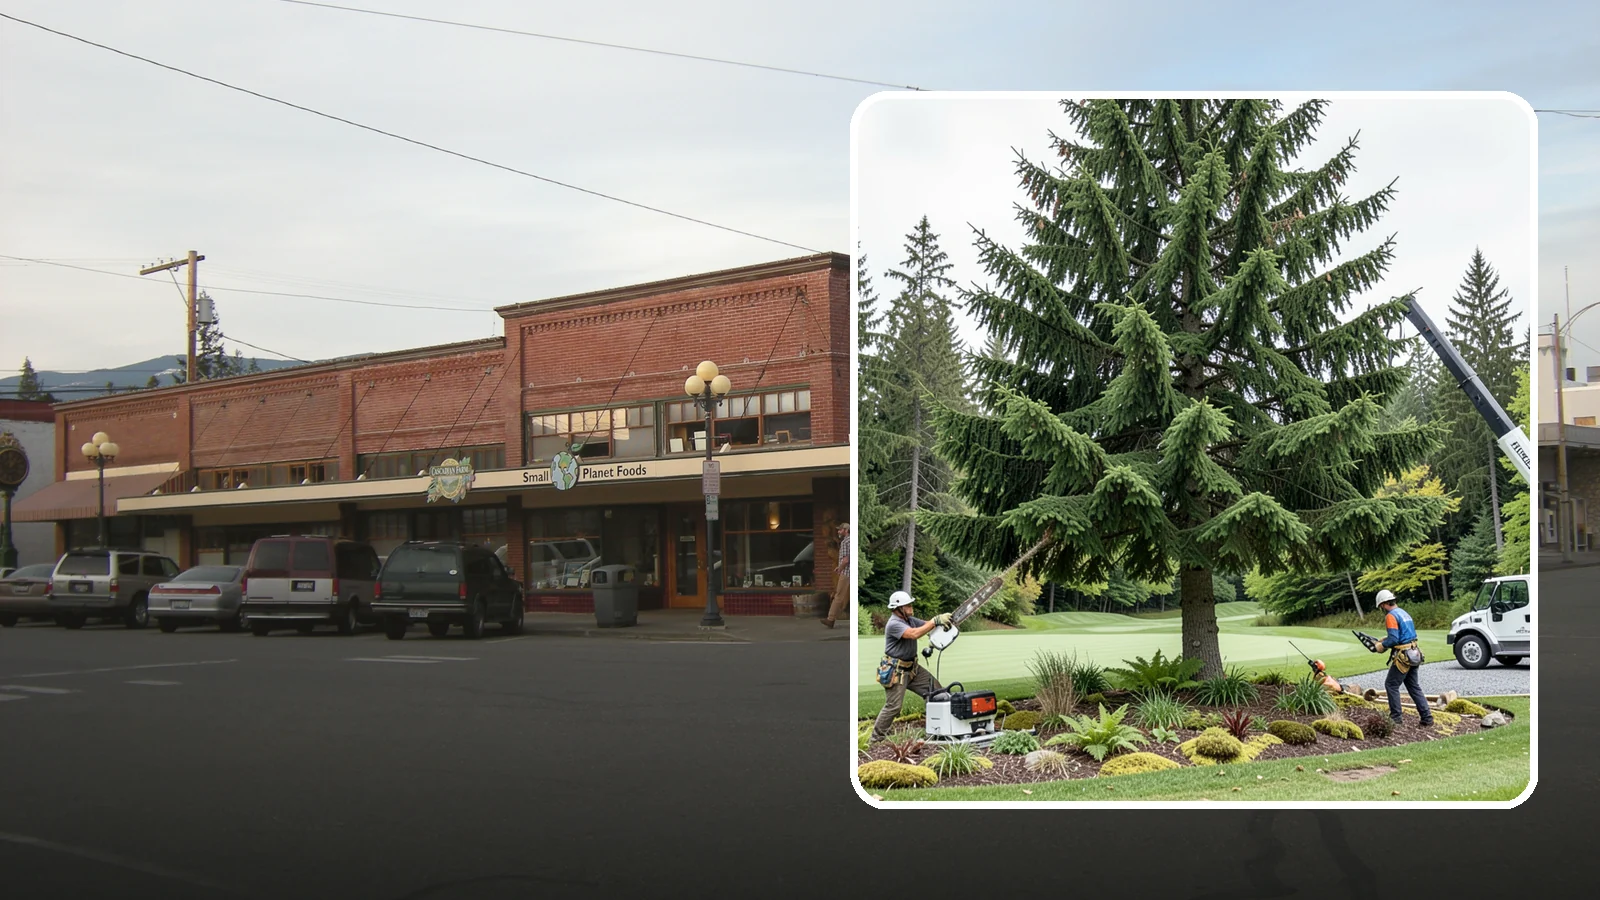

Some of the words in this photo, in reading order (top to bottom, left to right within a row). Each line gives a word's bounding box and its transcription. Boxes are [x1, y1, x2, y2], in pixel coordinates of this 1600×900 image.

[523, 471, 549, 483] Small
[583, 467, 614, 479] Planet
[617, 464, 647, 477] Foods
